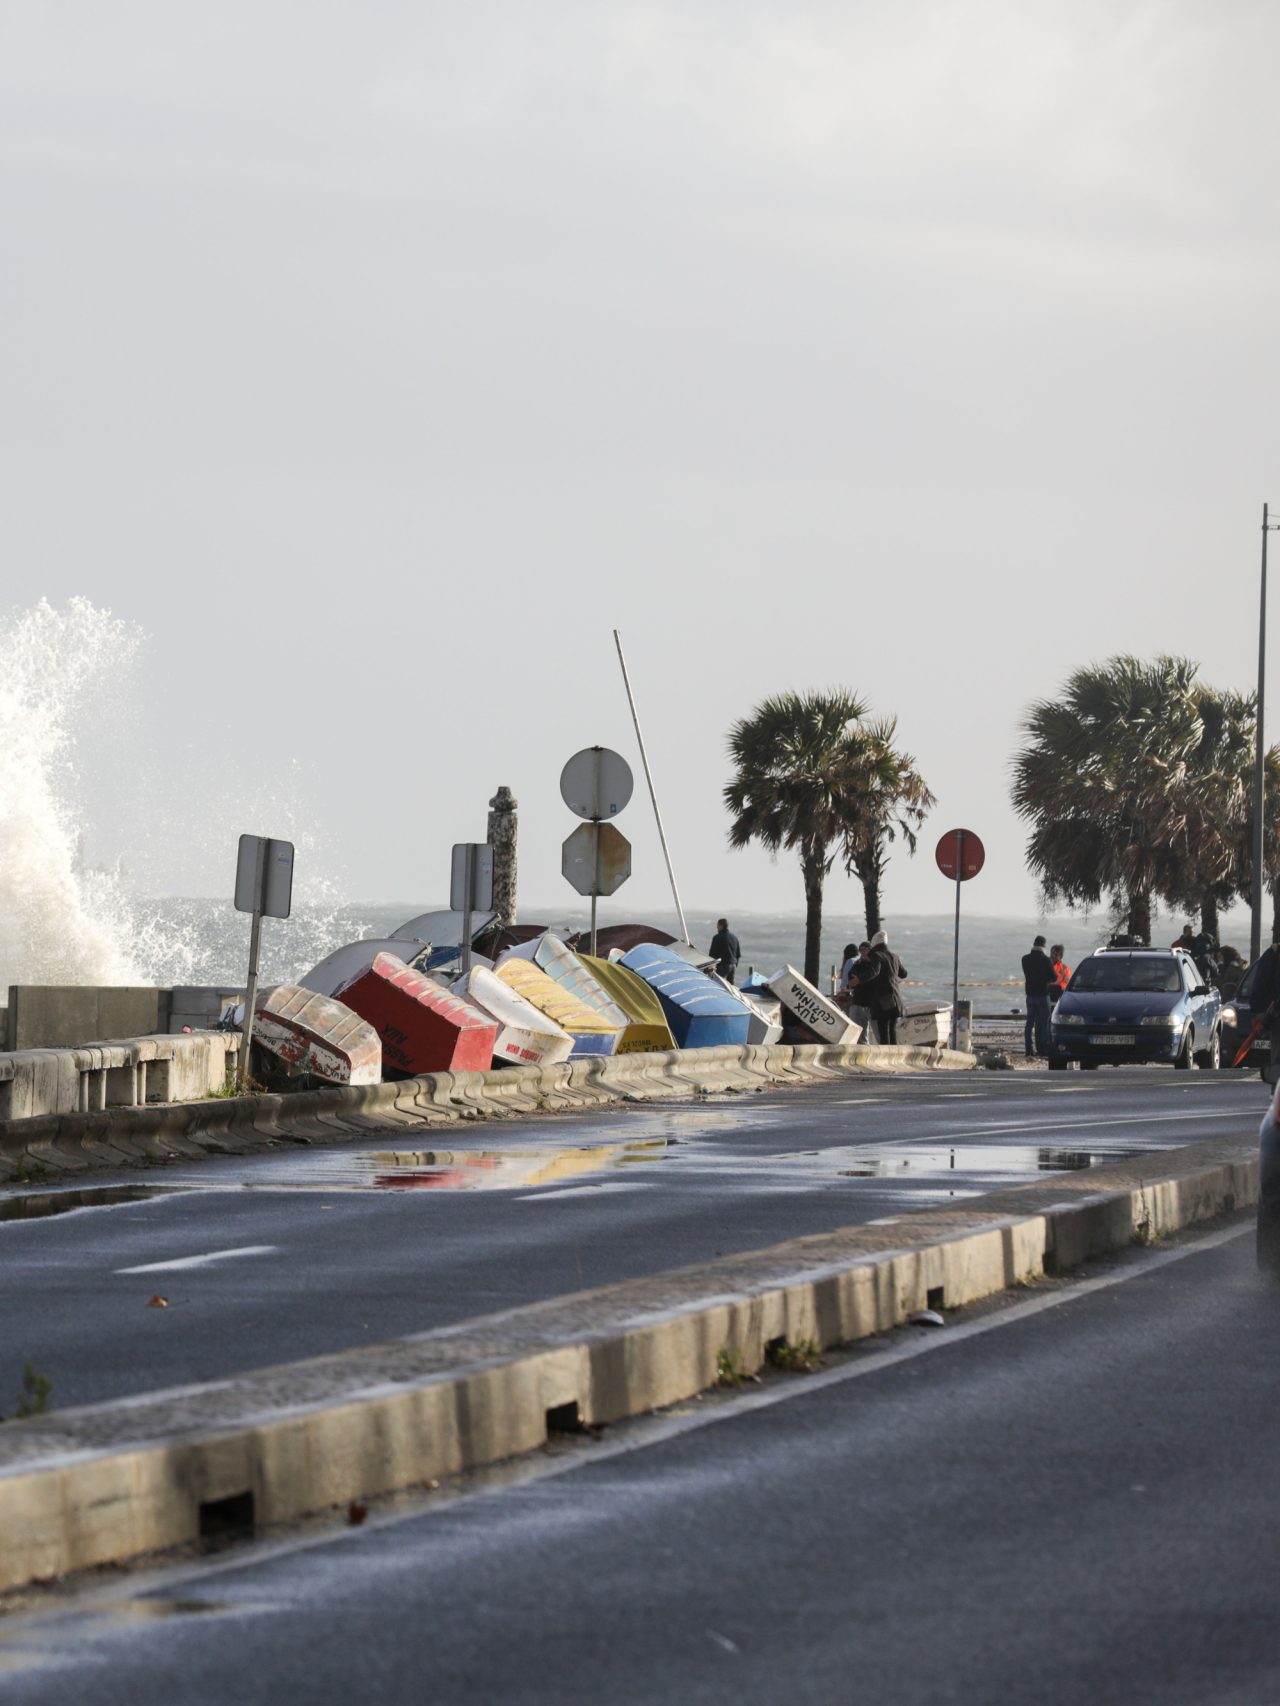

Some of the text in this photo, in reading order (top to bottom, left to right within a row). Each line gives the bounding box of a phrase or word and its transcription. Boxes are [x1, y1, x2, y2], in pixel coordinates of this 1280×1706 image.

[791, 983, 835, 1025] CEUZINHA
[793, 1002, 819, 1024] AUX
[384, 1024, 408, 1044] AUX
